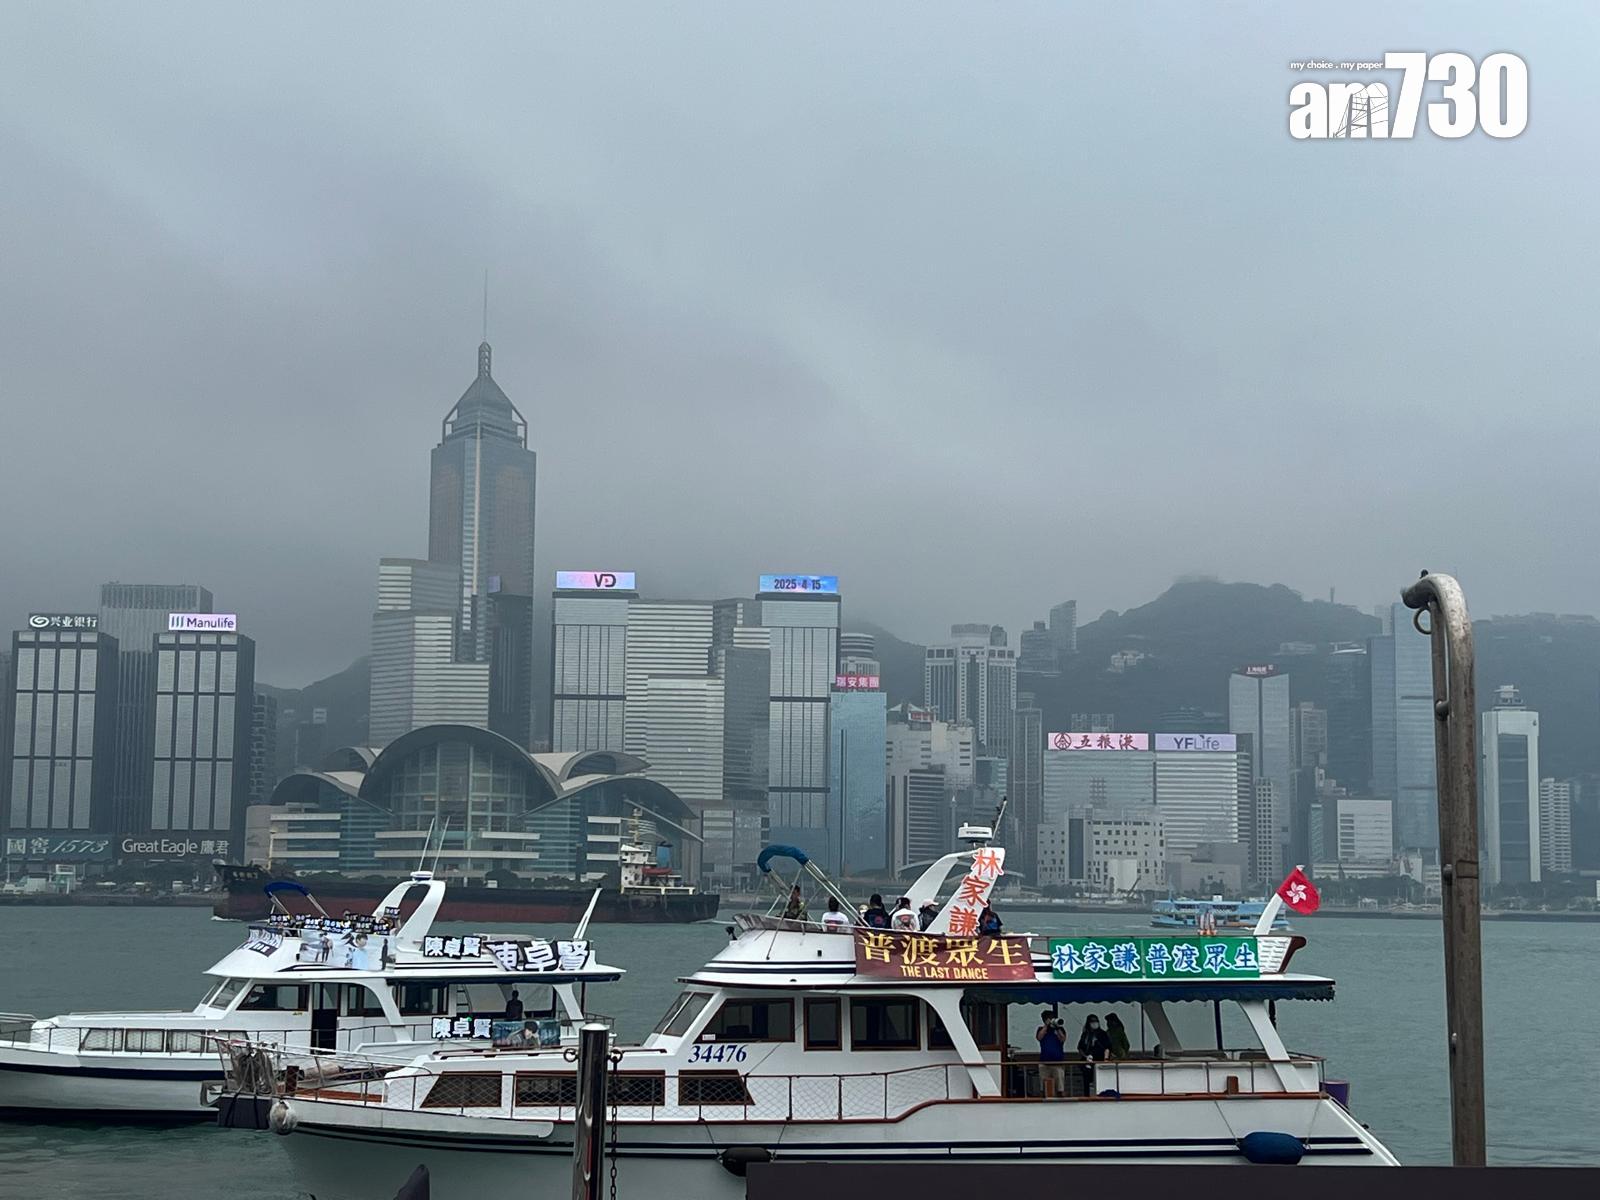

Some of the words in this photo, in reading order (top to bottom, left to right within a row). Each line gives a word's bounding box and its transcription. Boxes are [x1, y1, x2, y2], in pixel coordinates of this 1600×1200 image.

[774, 578, 797, 590] 2025
[811, 578, 821, 590] 15
[186, 616, 235, 629] Manulife
[121, 839, 160, 854] Great
[162, 839, 198, 857] Eagle
[949, 848, 1003, 936] 林家謙
[858, 931, 1028, 967] 普渡眾生
[901, 964, 922, 977] THE
[924, 966, 950, 979] LAST
[953, 966, 989, 980] DANCE
[687, 1044, 748, 1064] 34476
